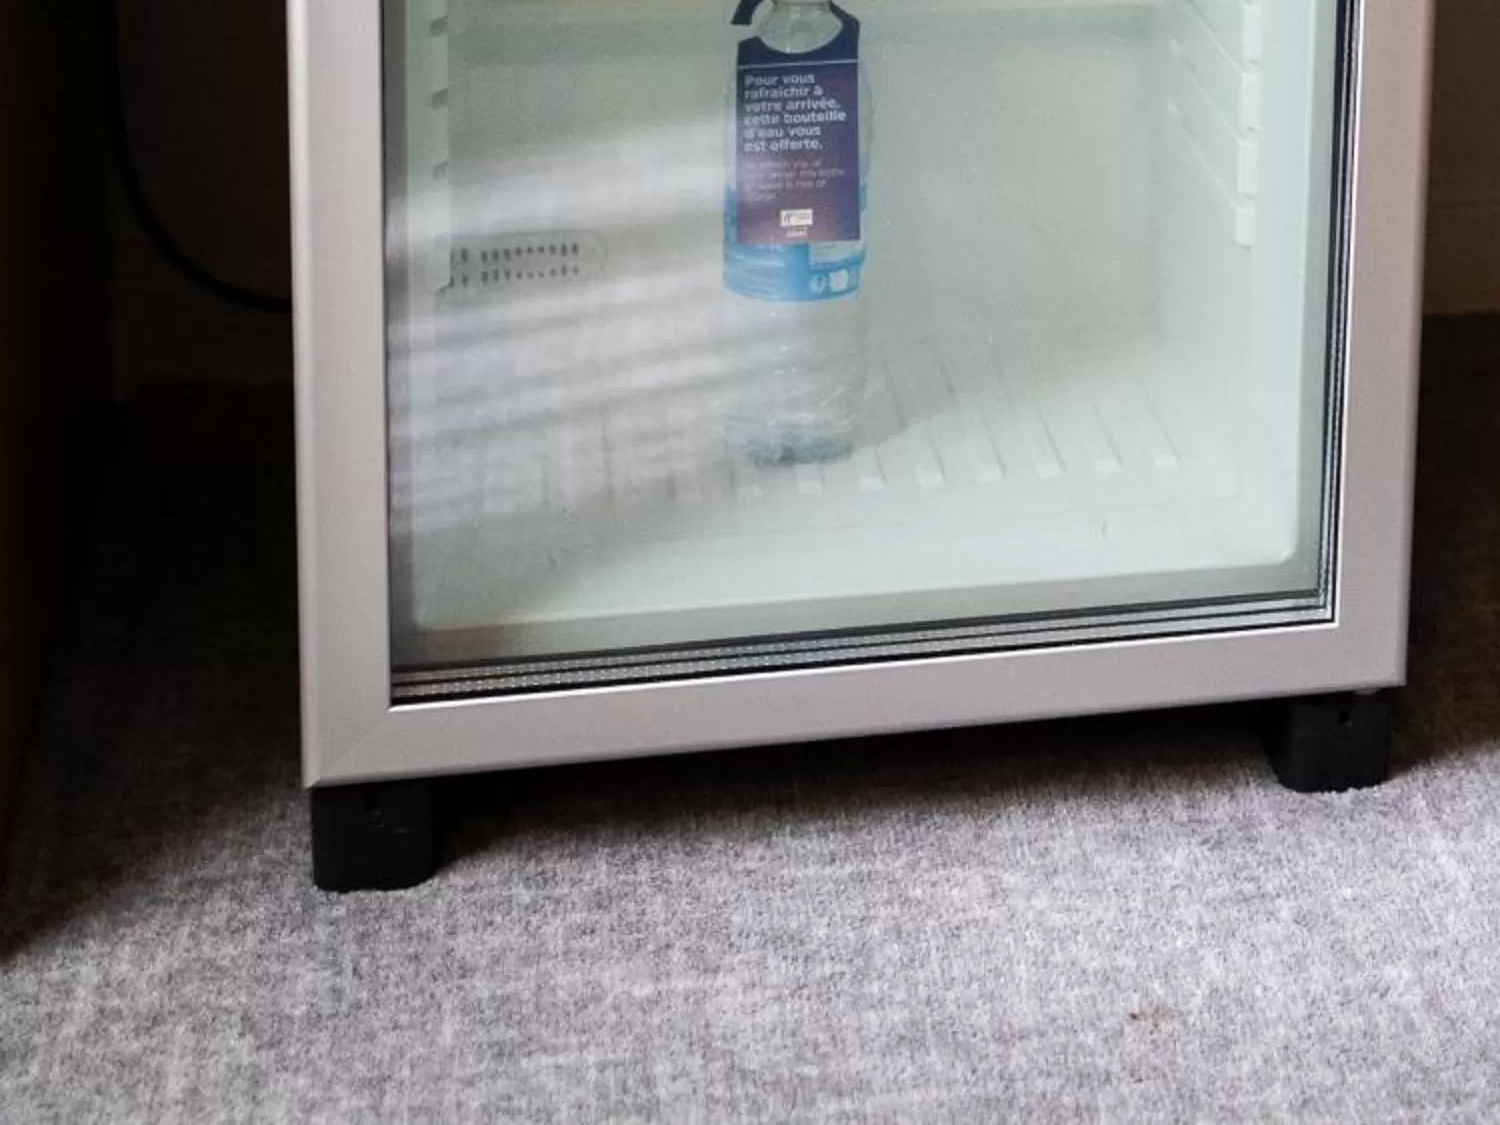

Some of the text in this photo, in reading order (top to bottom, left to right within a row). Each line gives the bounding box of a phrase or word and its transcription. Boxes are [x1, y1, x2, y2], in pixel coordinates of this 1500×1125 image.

[744, 74, 815, 86] Pour vous
[813, 84, 824, 96] à
[744, 101, 782, 112] votre
[743, 110, 847, 125] cette bouteille
[787, 126, 821, 137] vous
[744, 138, 823, 152] est offerte.
